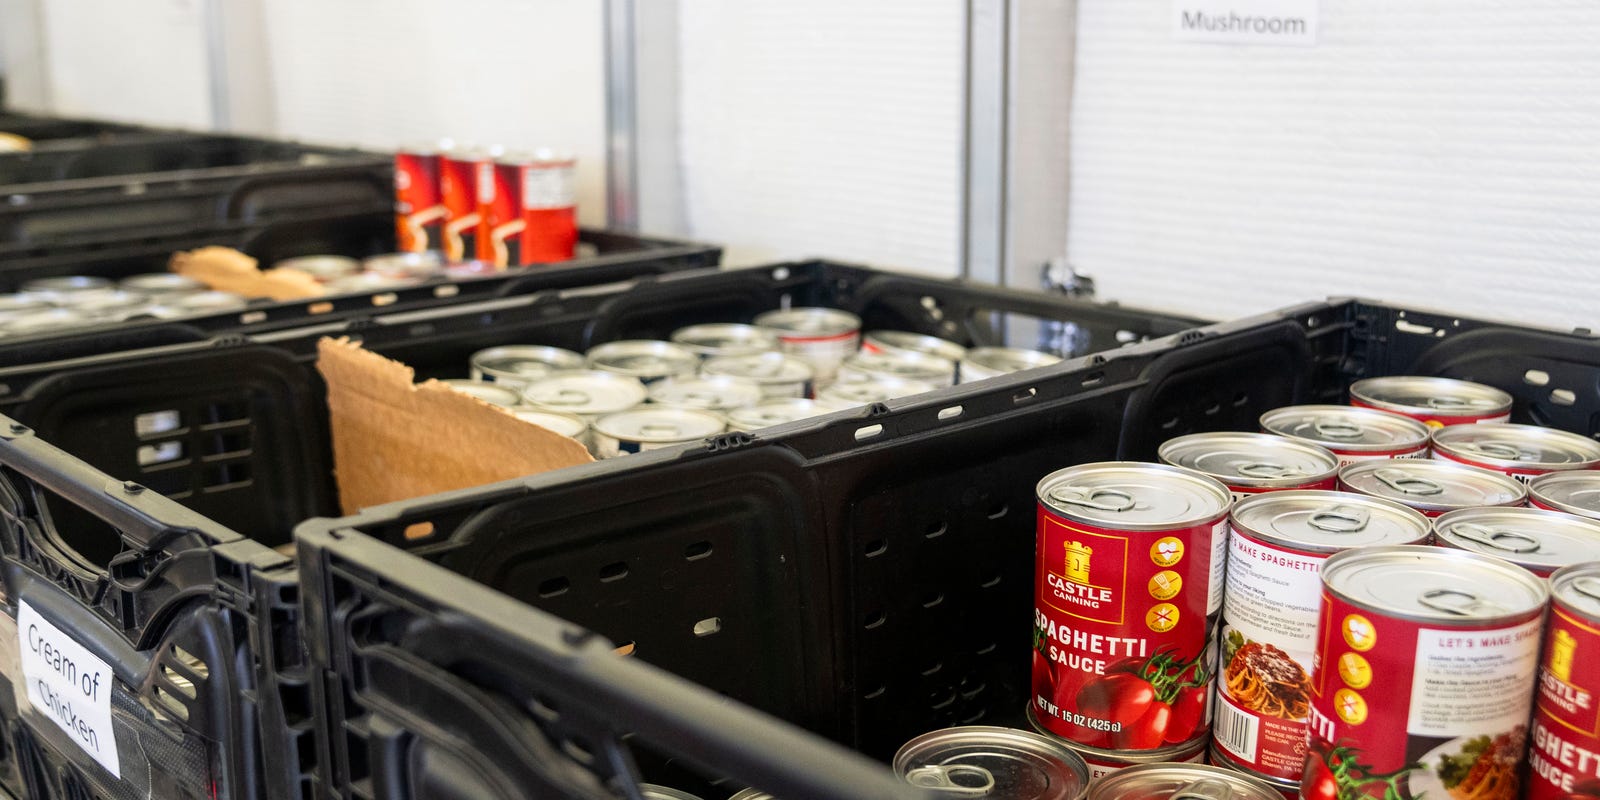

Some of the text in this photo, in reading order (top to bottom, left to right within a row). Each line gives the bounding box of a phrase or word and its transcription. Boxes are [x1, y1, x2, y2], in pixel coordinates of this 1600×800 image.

[1181, 9, 1306, 34] Mushroom
[1238, 541, 1257, 558] MAKE
[1261, 552, 1319, 573] SPAGHETTI
[1047, 573, 1112, 602] CASTLE
[1053, 589, 1100, 609] CANNING
[1035, 607, 1147, 657] SPAGHETTI
[1438, 637, 1474, 648] LET'S
[1481, 635, 1511, 647] MAKE
[27, 623, 100, 702] Cream of
[1050, 645, 1106, 675] SAUCE
[37, 679, 100, 753] Chicken
[1037, 694, 1047, 711] NET
[1048, 702, 1060, 718] WT.
[1062, 709, 1072, 723] 15
[1073, 713, 1086, 727] OZ
[1264, 721, 1280, 730] MADE
[1287, 726, 1299, 734] THE
[1264, 729, 1285, 739] PLEASE
[1264, 734, 1277, 742] THIS
[1261, 754, 1284, 765] CASTLE
